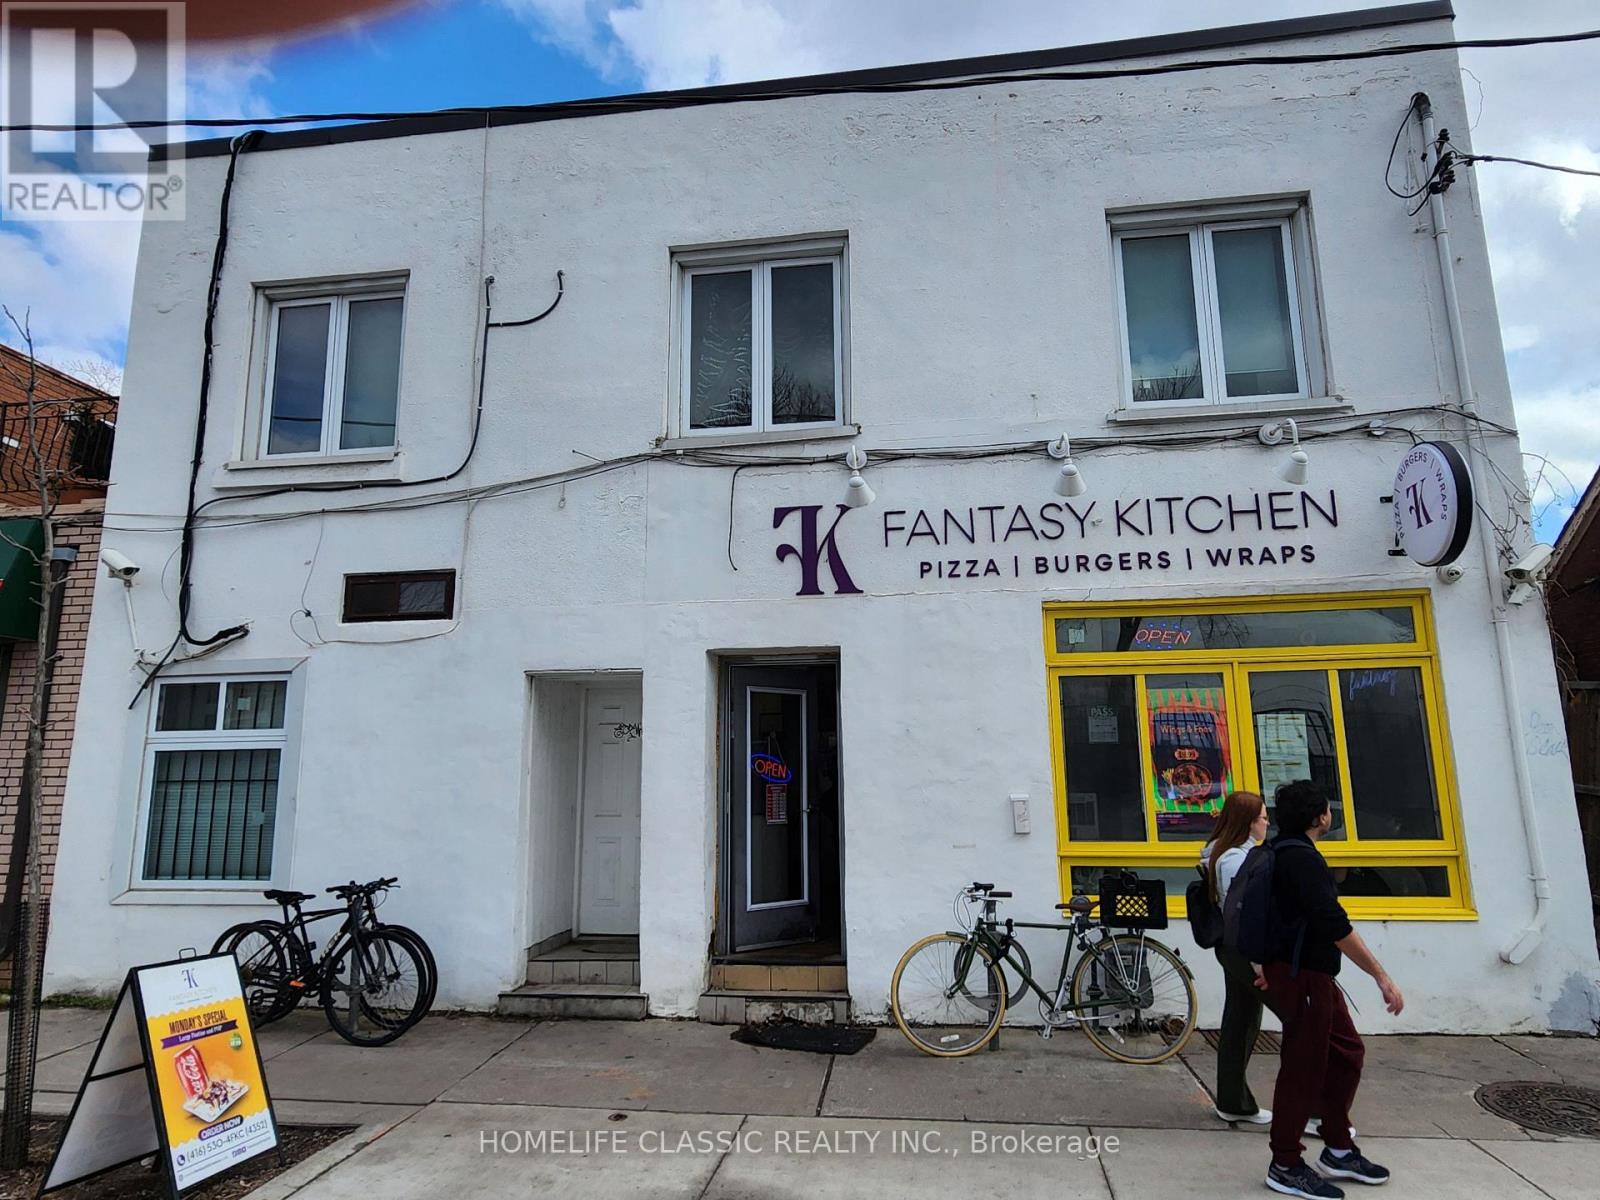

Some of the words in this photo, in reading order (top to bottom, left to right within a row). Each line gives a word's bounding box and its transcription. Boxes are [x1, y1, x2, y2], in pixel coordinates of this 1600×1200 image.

[1397, 451, 1428, 482] BURGERS
[1435, 468, 1448, 521] WRAPS
[883, 499, 1098, 548] FANTASY
[1115, 489, 1339, 537] KITCHEN
[919, 557, 1001, 579] PIZZA
[1034, 549, 1172, 575] BURGERS
[1205, 543, 1317, 567] WRAPS
[1135, 629, 1192, 645] OPEN
[1160, 724, 1186, 736] Wings
[754, 759, 787, 779] OPEN
[168, 1014, 203, 1034] MONDAY'S
[203, 1009, 228, 1026] SPECIAL
[200, 1123, 224, 1139] ORDER
[223, 1117, 241, 1130] NOW
[186, 1146, 206, 1163] (416)
[245, 1119, 268, 1137] (4352)
